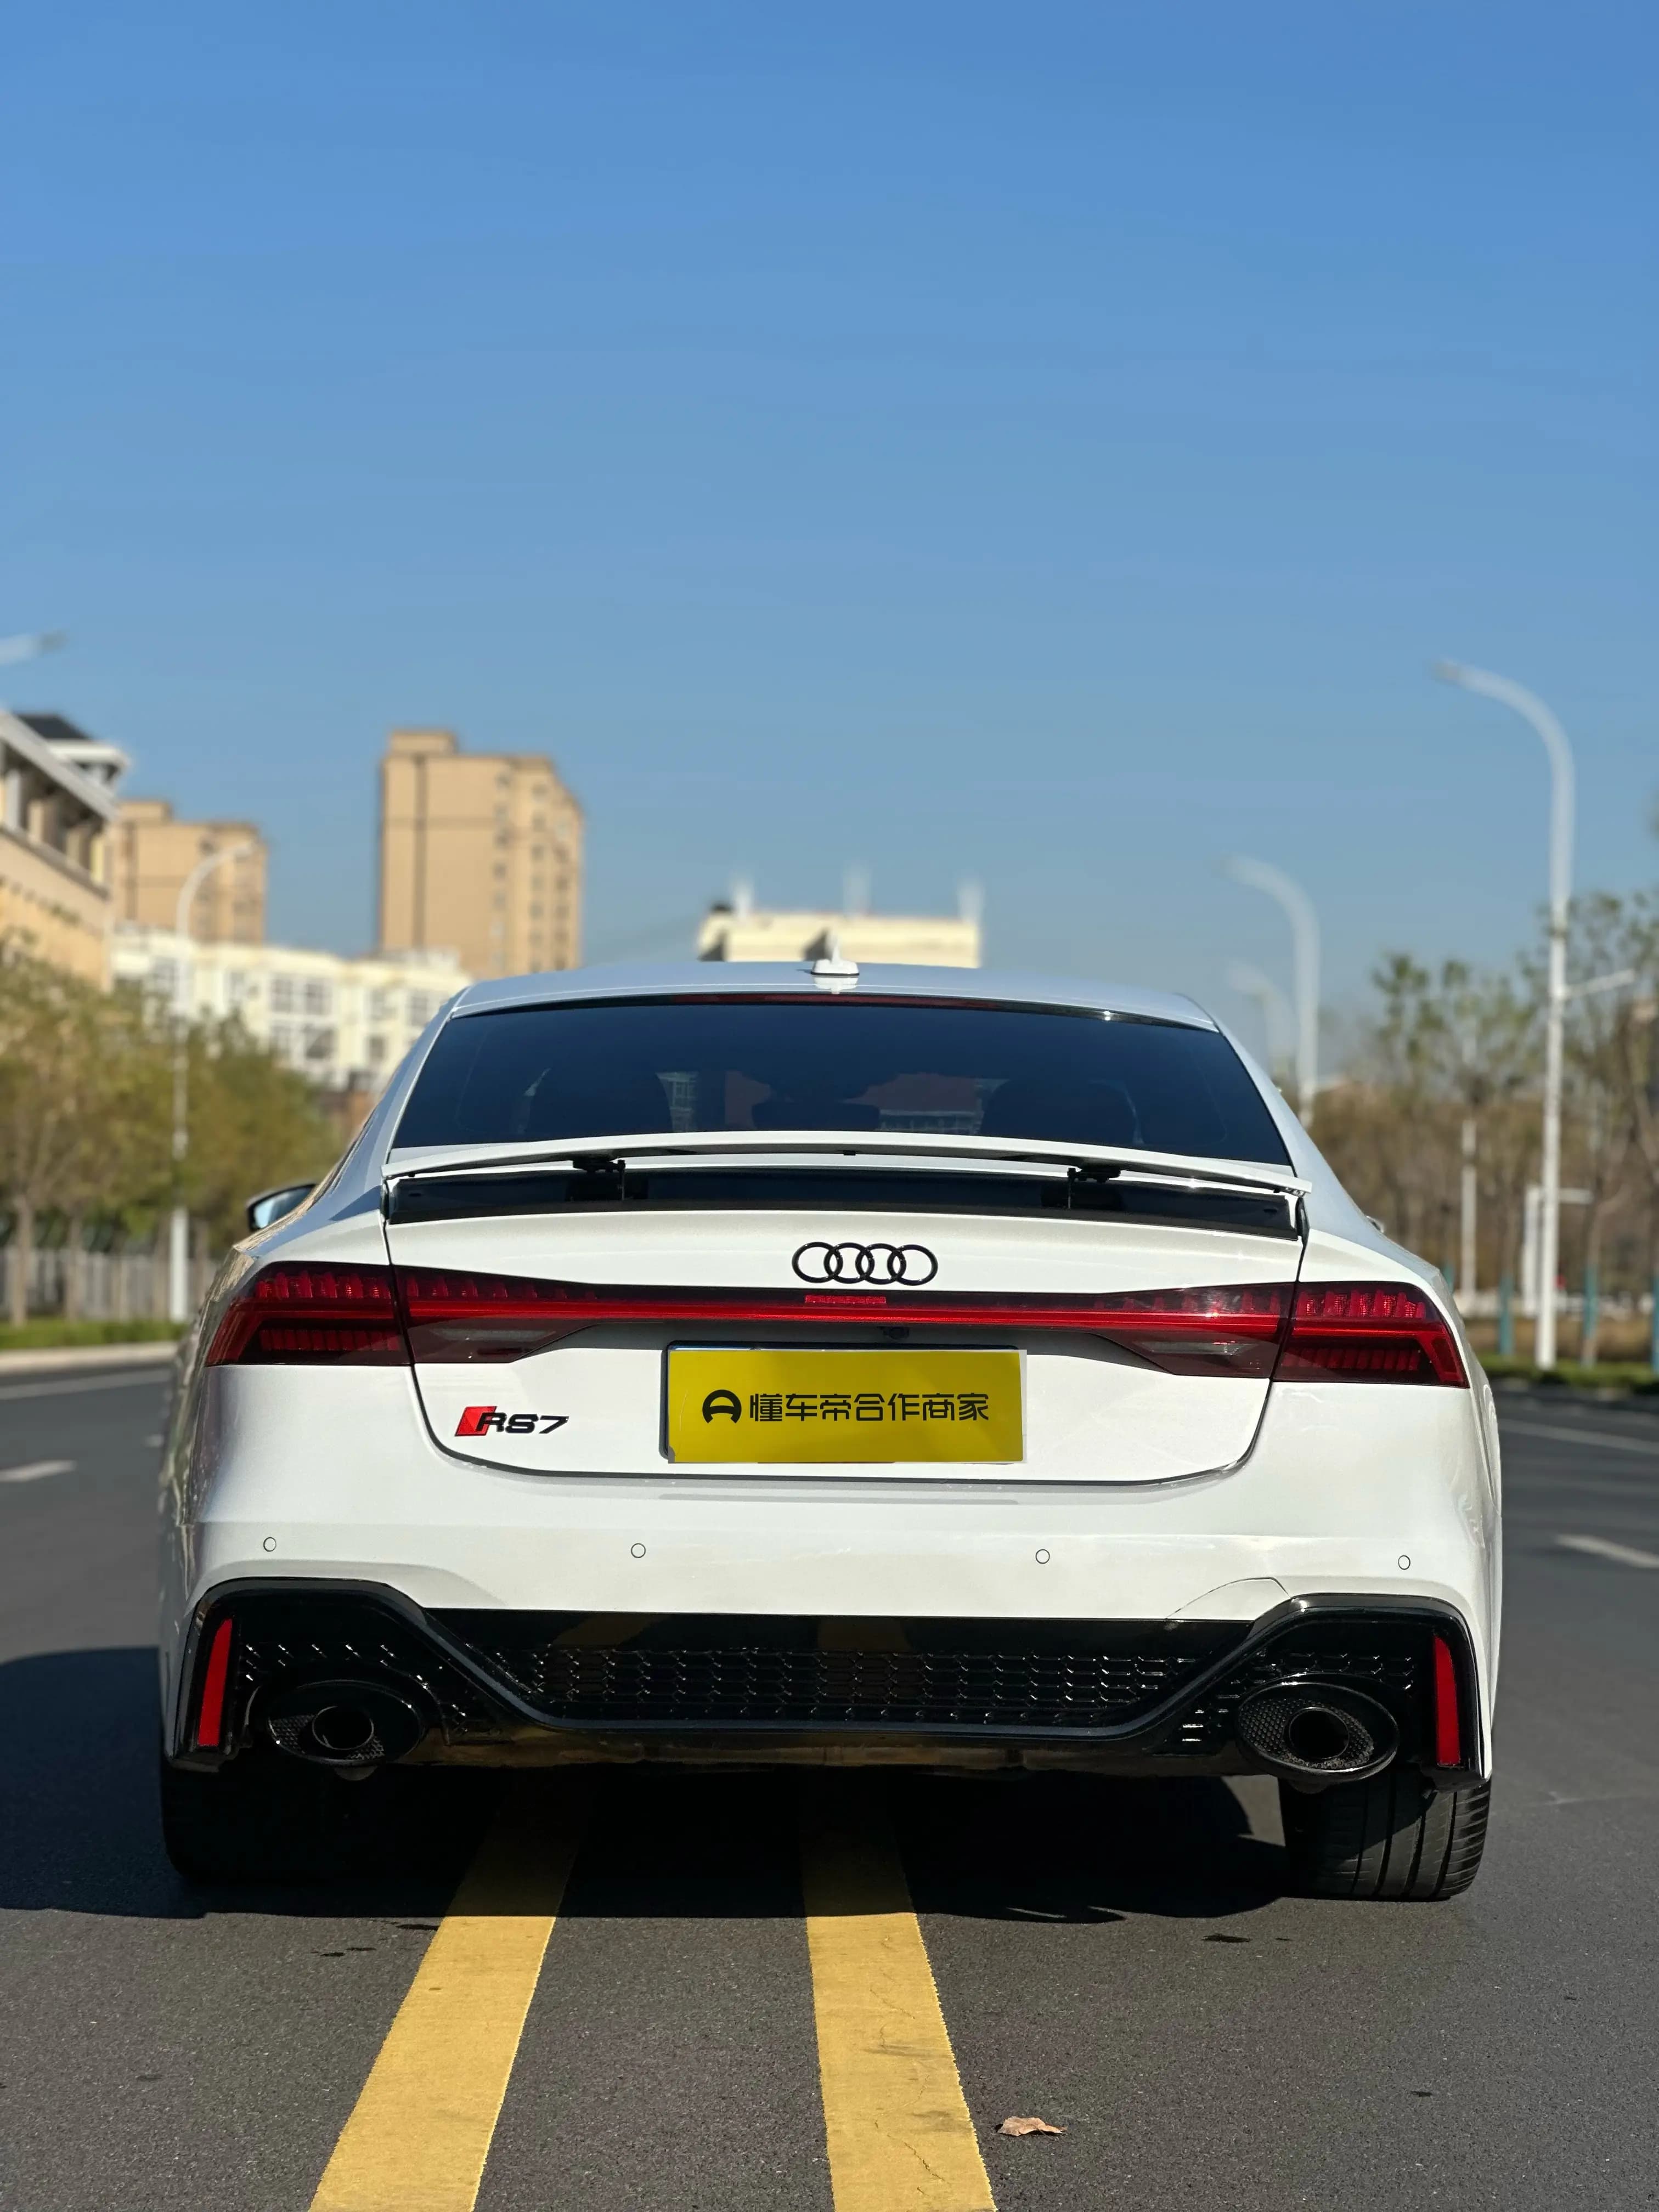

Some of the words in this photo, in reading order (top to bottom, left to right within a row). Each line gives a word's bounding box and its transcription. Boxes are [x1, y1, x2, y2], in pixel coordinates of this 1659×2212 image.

[749, 1392, 989, 1421] 懂车帝合作商家
[475, 1412, 569, 1434] RS7
